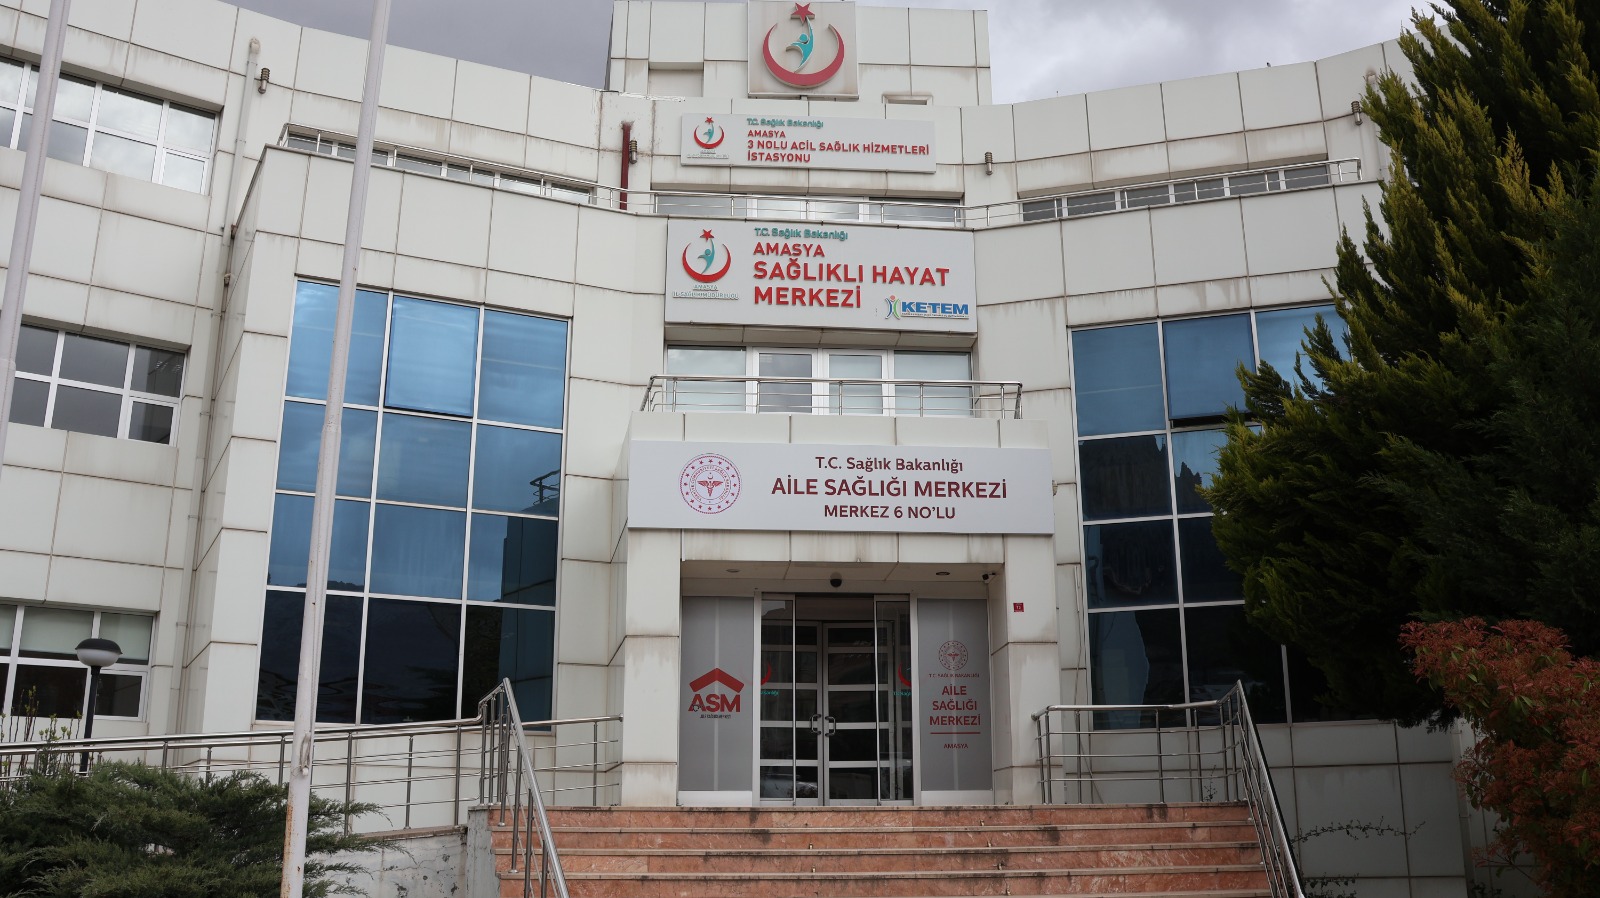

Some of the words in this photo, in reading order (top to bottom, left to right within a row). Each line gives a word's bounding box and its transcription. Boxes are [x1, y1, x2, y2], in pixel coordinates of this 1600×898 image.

[746, 118, 760, 126] T.C.
[760, 118, 785, 128] Sağlık
[787, 119, 824, 130] Bakanlığı
[748, 130, 786, 138] AMASYA
[748, 140, 753, 149] 3
[757, 141, 788, 150] NOLU
[790, 140, 816, 151] ACİL
[819, 141, 860, 153] SAĞLIK
[863, 142, 929, 155] HİZMETLERİ
[748, 149, 810, 162] İSTASYONU
[754, 228, 770, 237] T.C.
[772, 228, 801, 239] Sağlık
[804, 229, 848, 241] Bakanlığı
[753, 242, 824, 258] AMASYA
[753, 258, 864, 282] SAĞLIKLI
[872, 265, 950, 286] HAYAT
[754, 286, 860, 308] MERKEZİ
[902, 302, 968, 315] KETEM
[815, 456, 842, 469] T.C.
[846, 457, 891, 472] Sağlık
[896, 458, 963, 474] Bakanlığı
[772, 474, 818, 494] AİLE
[824, 476, 906, 496] SAĞLIĞI
[914, 478, 1006, 498] MERKEZİ
[824, 505, 889, 518] MERKEZ
[894, 506, 903, 518] 6
[942, 684, 966, 696] AİLE
[688, 694, 740, 712] ASM
[932, 699, 976, 710] SAĞLIĞI
[930, 714, 980, 726] MERKEZİ
